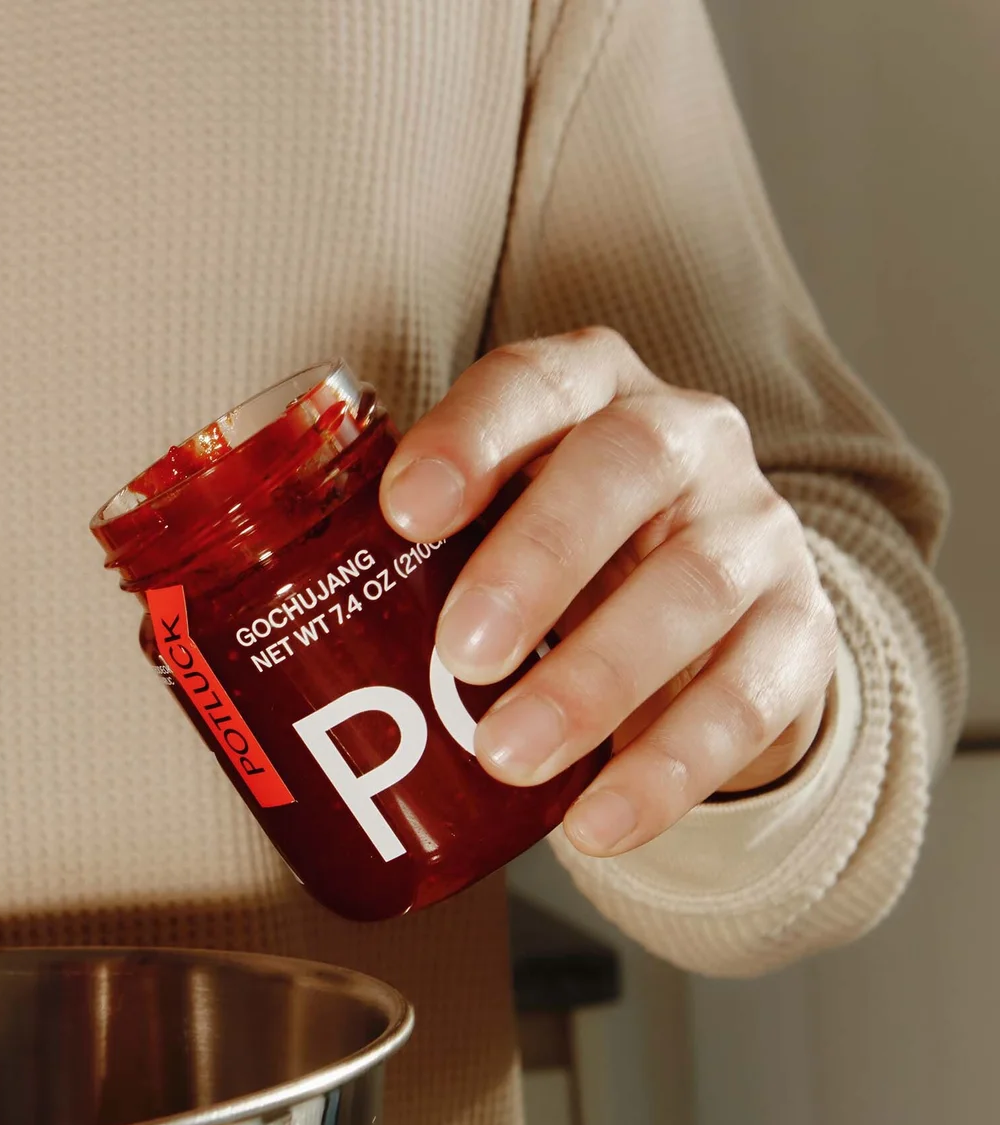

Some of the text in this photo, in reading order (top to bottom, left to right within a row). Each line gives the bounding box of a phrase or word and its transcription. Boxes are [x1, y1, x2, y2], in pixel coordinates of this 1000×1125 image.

[235, 549, 376, 647] GOCHUJANG
[251, 538, 447, 673] NET WT 7.4 OZ (210
[161, 613, 265, 776] POTLUCK
